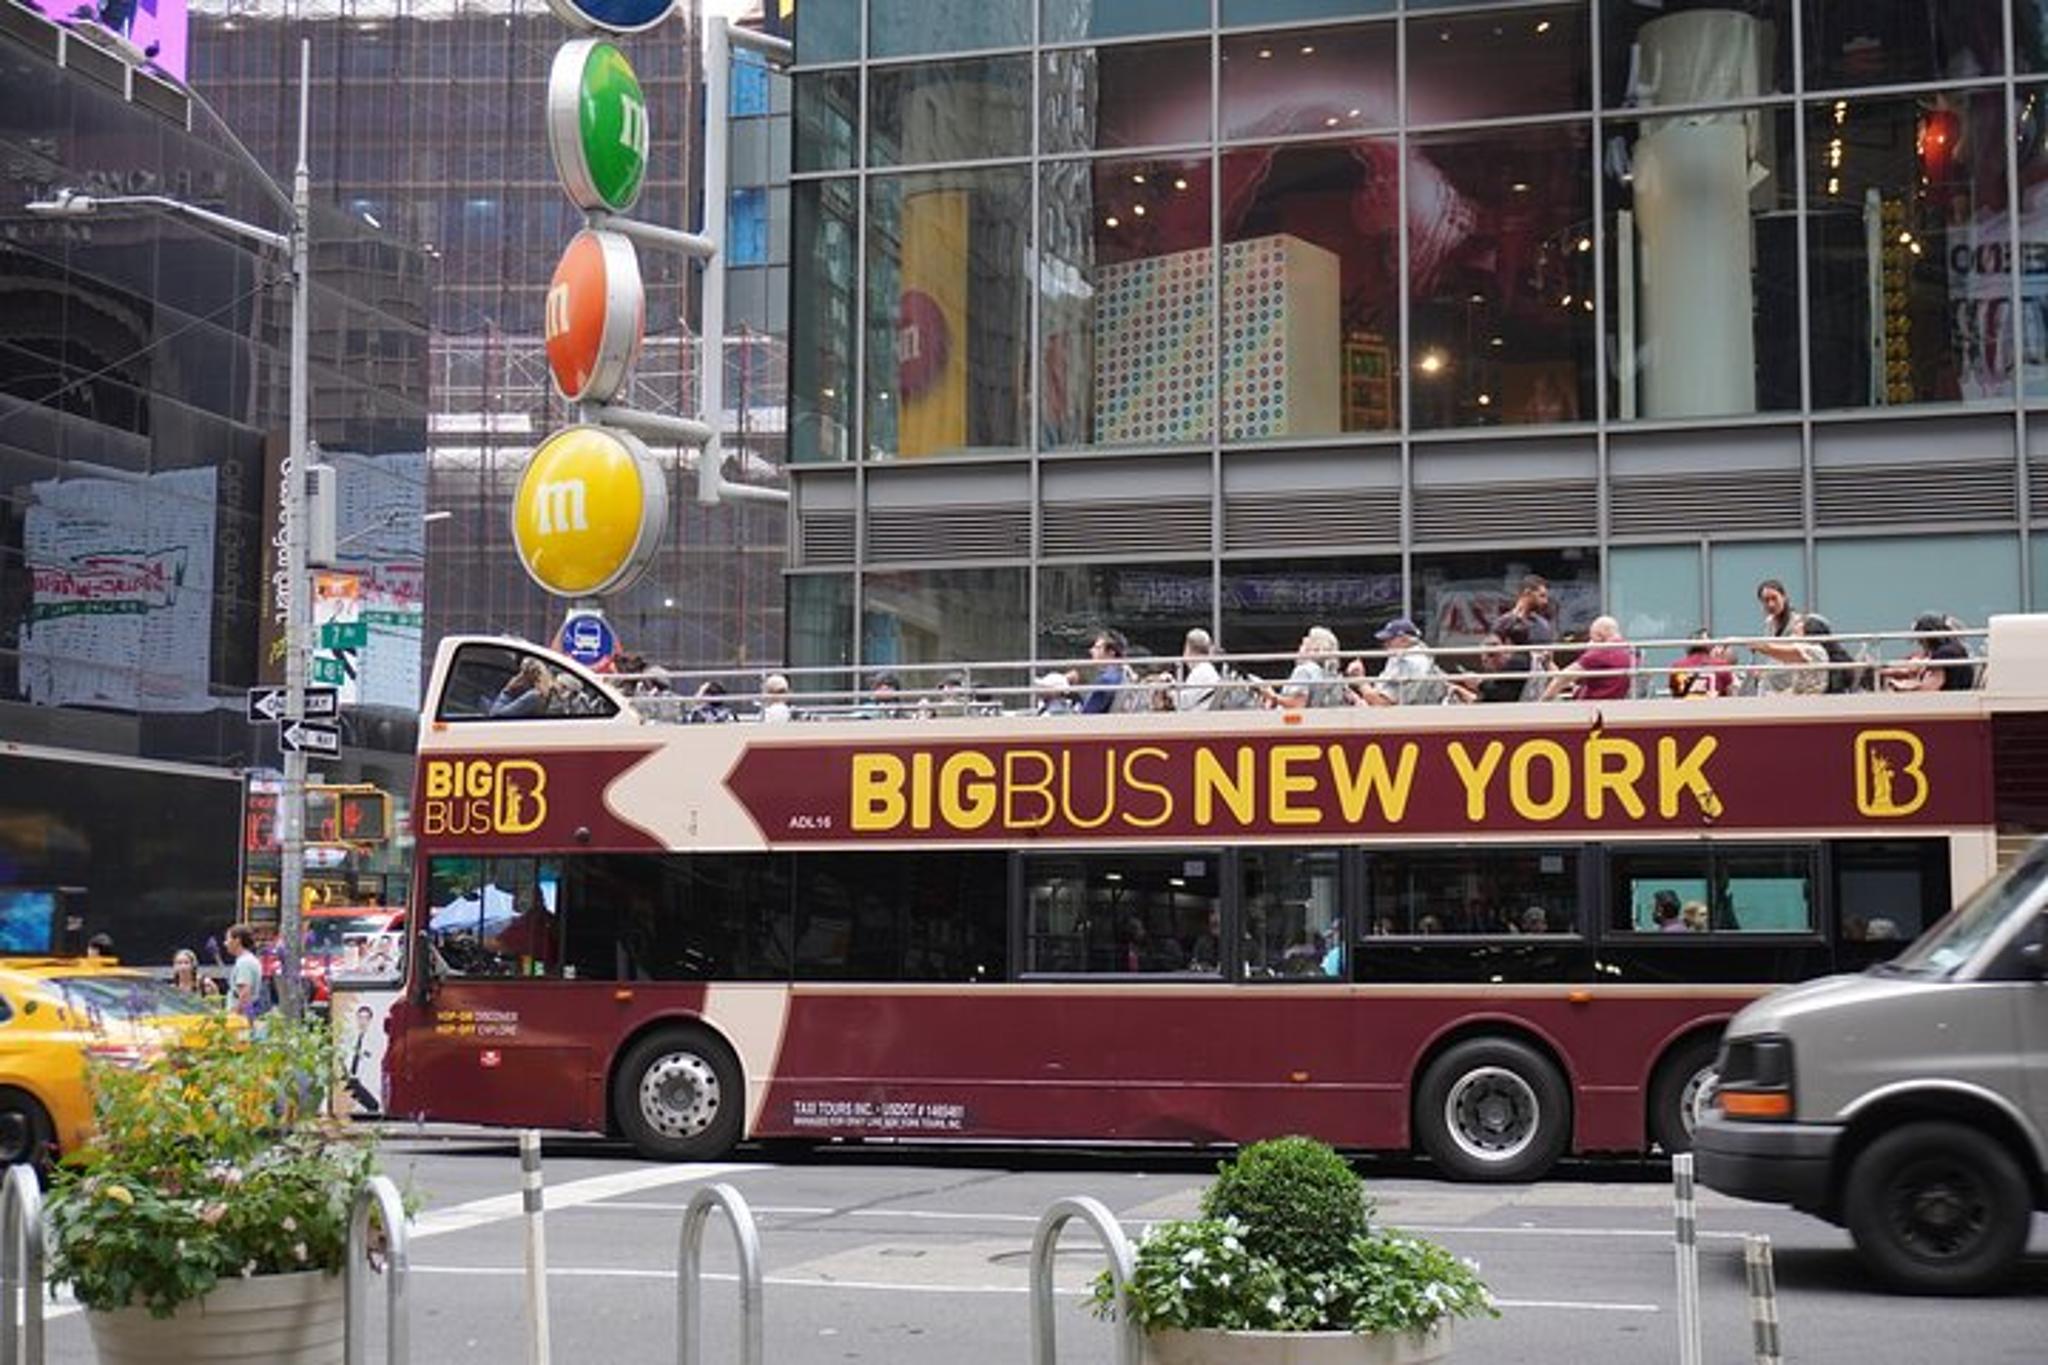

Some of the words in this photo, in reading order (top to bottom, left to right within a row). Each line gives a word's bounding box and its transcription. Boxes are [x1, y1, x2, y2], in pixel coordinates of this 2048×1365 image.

[536, 478, 588, 535] m
[426, 761, 493, 798] BIG
[1194, 742, 1419, 825] NEW
[1447, 733, 1724, 822] YORK
[424, 800, 491, 835] BUS
